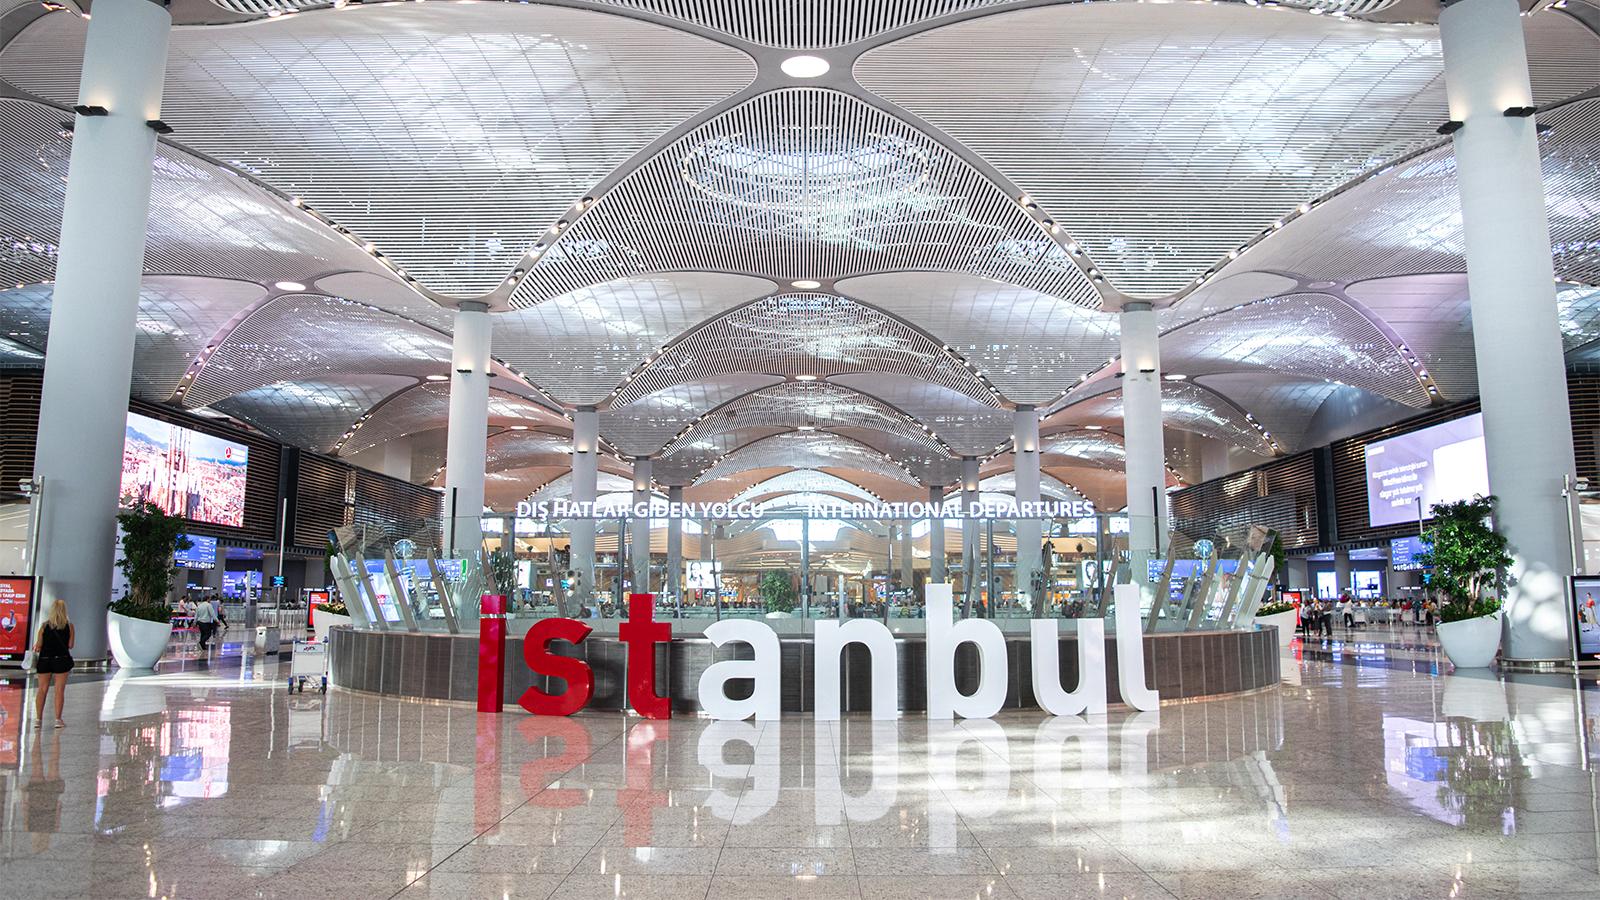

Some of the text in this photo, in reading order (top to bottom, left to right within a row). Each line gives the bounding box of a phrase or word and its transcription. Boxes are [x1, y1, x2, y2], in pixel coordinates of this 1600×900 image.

[517, 501, 549, 521] DIŞ
[553, 501, 629, 518] HATLAR
[699, 502, 763, 518] YOLCU
[808, 501, 1095, 518] INTERNATIONAL DEPARTURES
[477, 583, 1160, 720] istanbul
